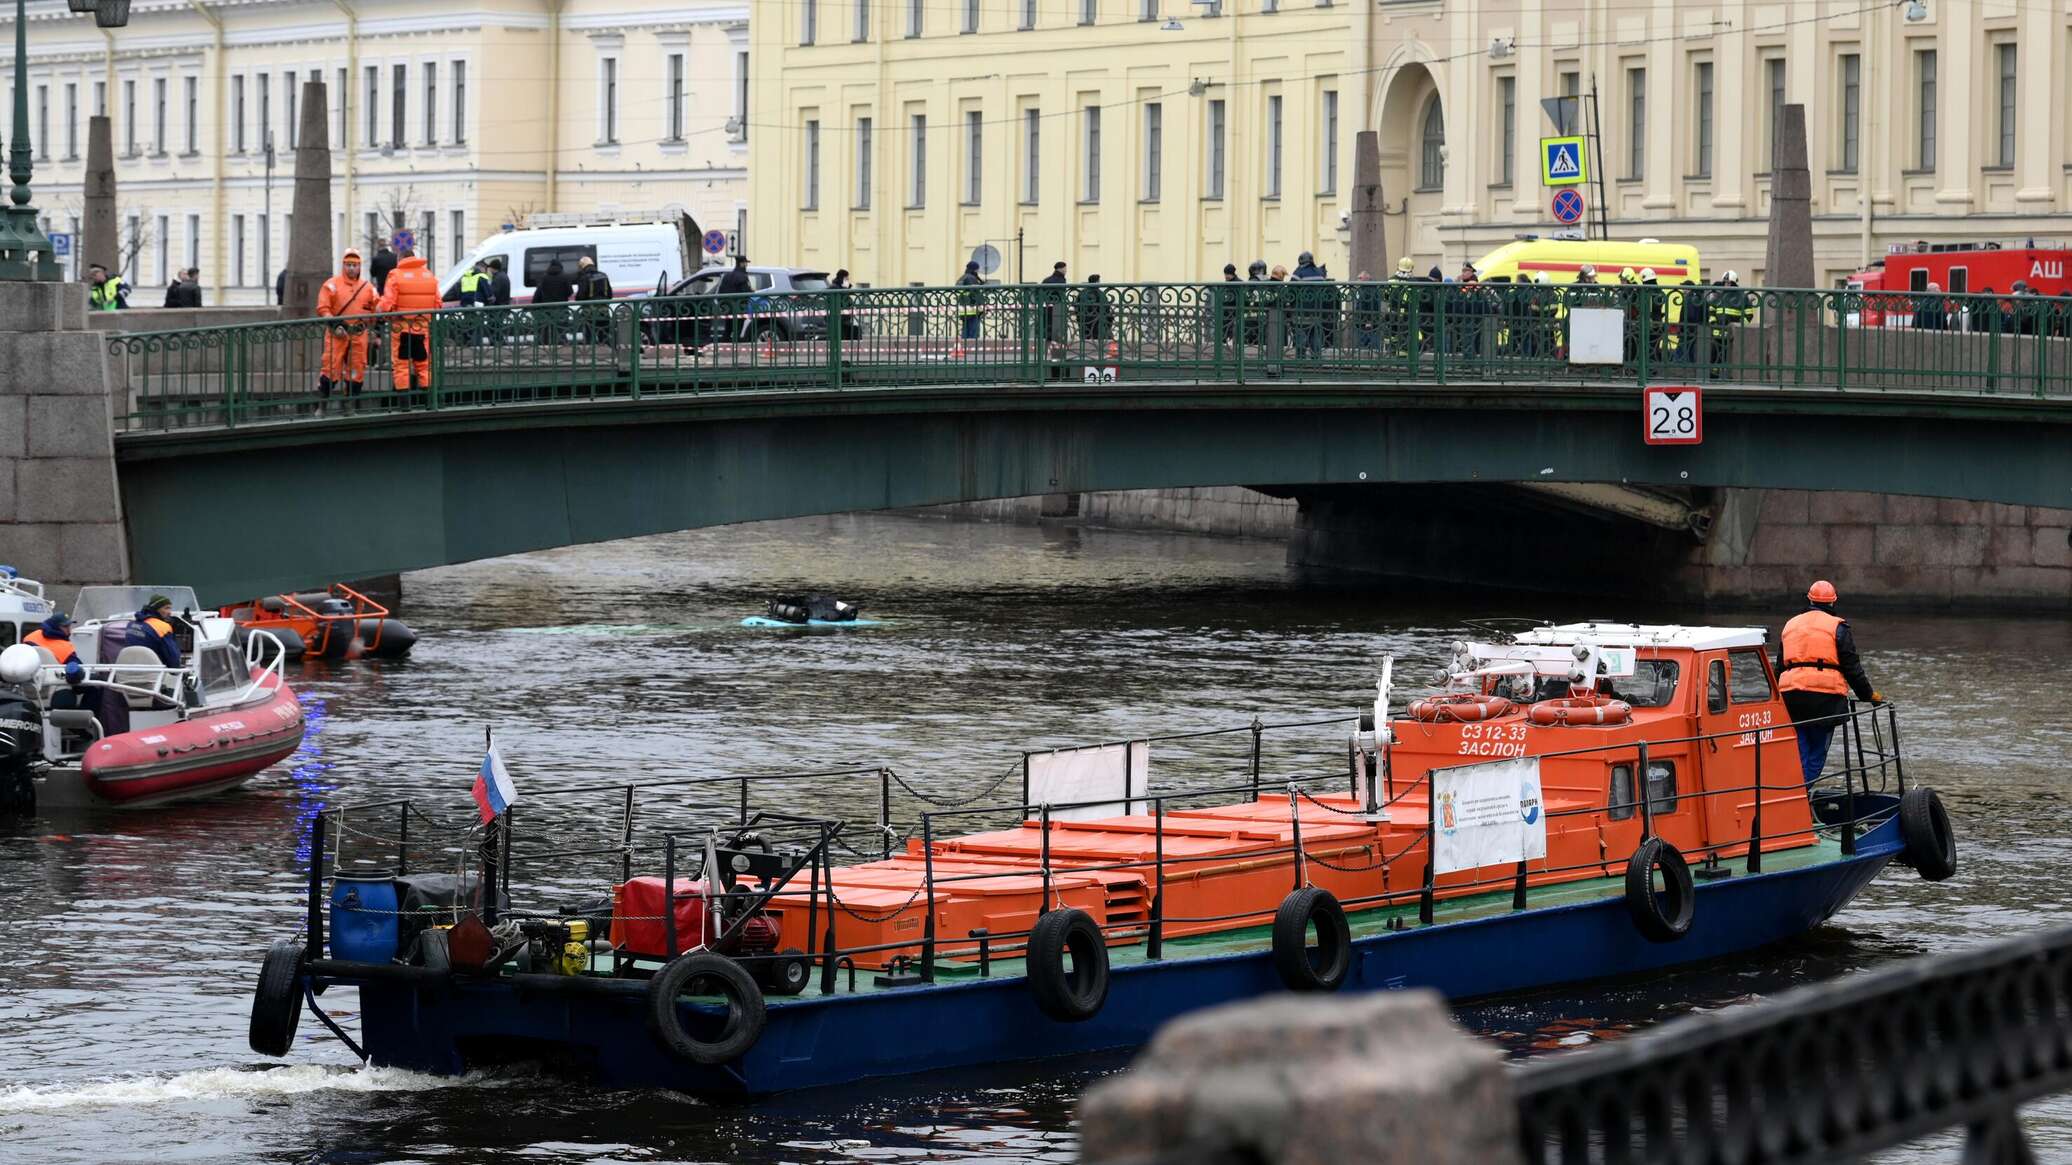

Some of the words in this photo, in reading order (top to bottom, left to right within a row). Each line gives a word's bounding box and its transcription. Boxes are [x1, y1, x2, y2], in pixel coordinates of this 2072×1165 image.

[2030, 260, 2063, 278] АШ
[1653, 407, 1695, 434] 2.8
[1458, 740, 1527, 757] ЗАСЛОН
